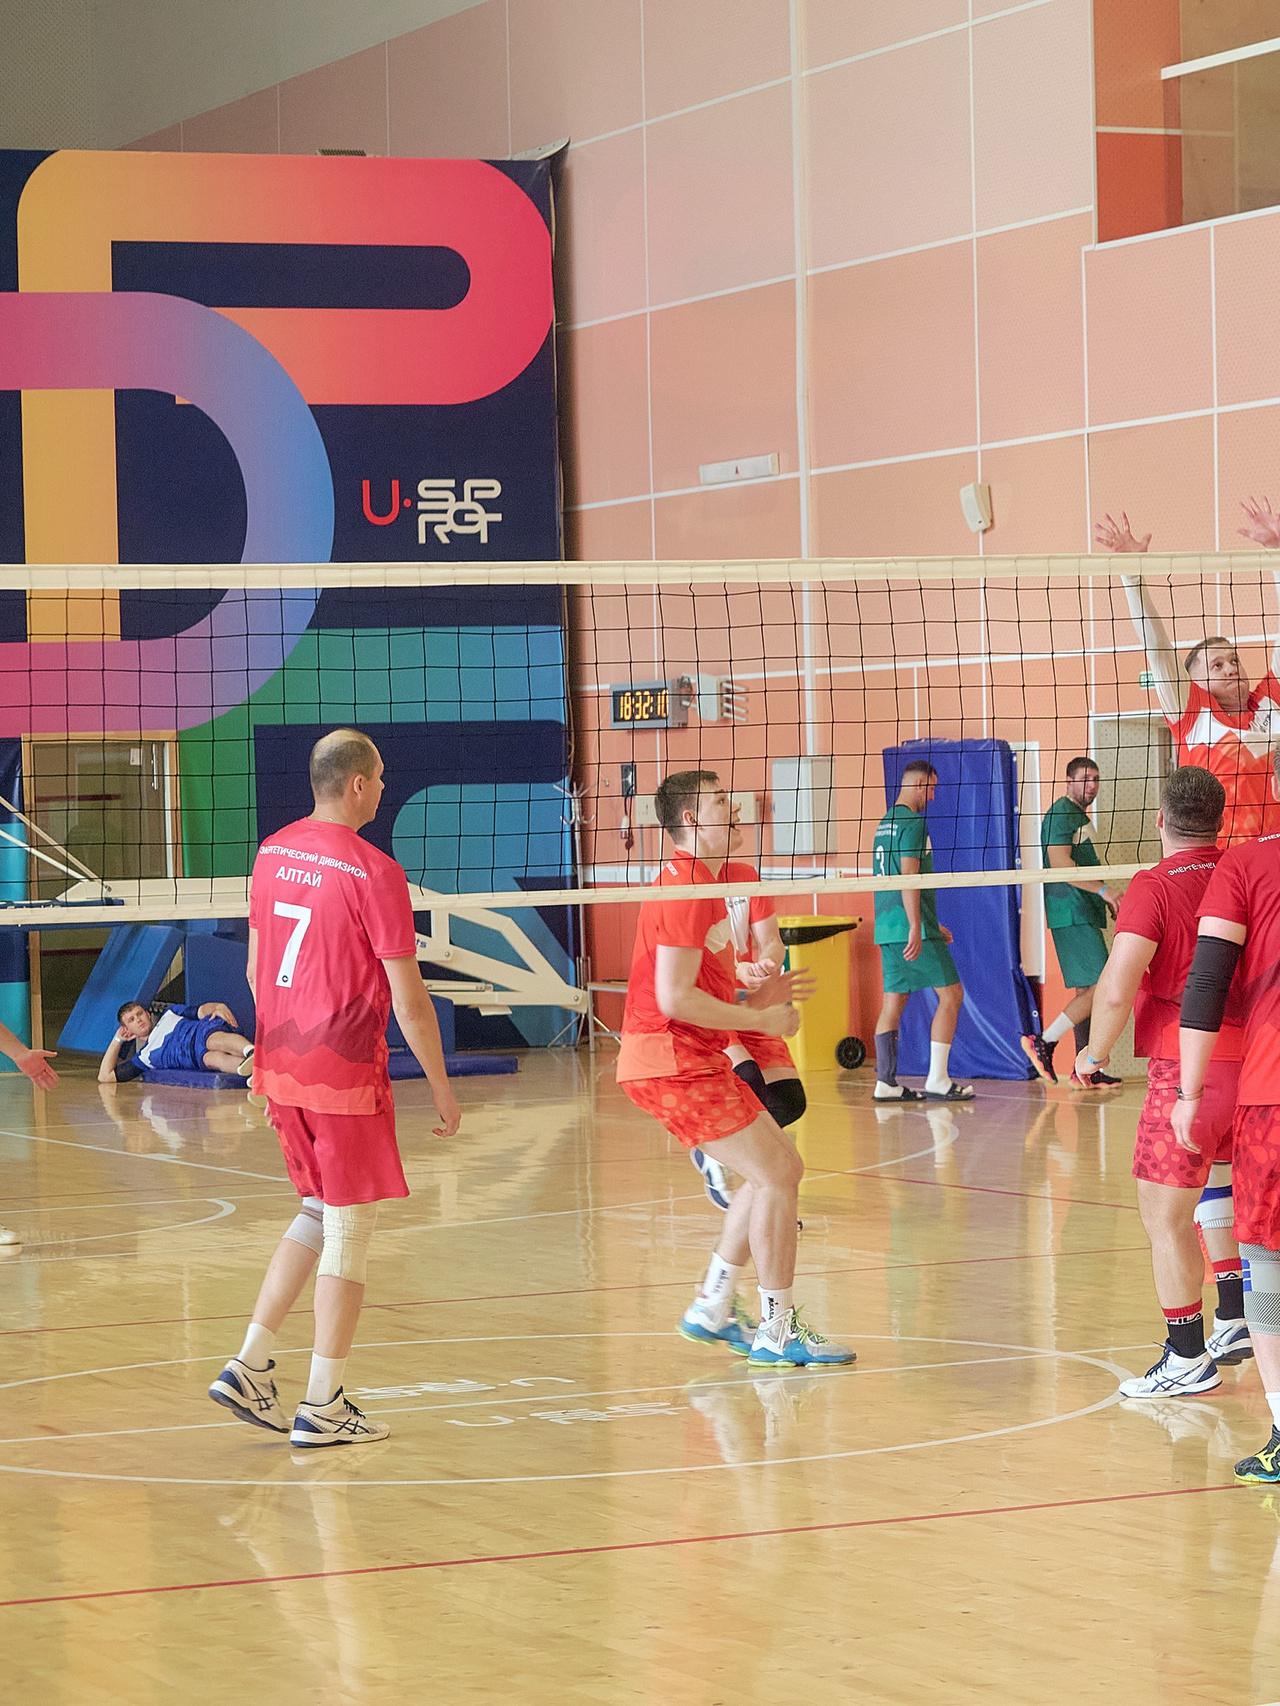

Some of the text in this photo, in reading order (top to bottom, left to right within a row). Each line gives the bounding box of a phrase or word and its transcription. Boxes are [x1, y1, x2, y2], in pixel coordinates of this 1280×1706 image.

[274, 865, 323, 888] АЛТАЙ
[317, 855, 368, 881] ДИВИЗИОН
[273, 900, 313, 988] 7
